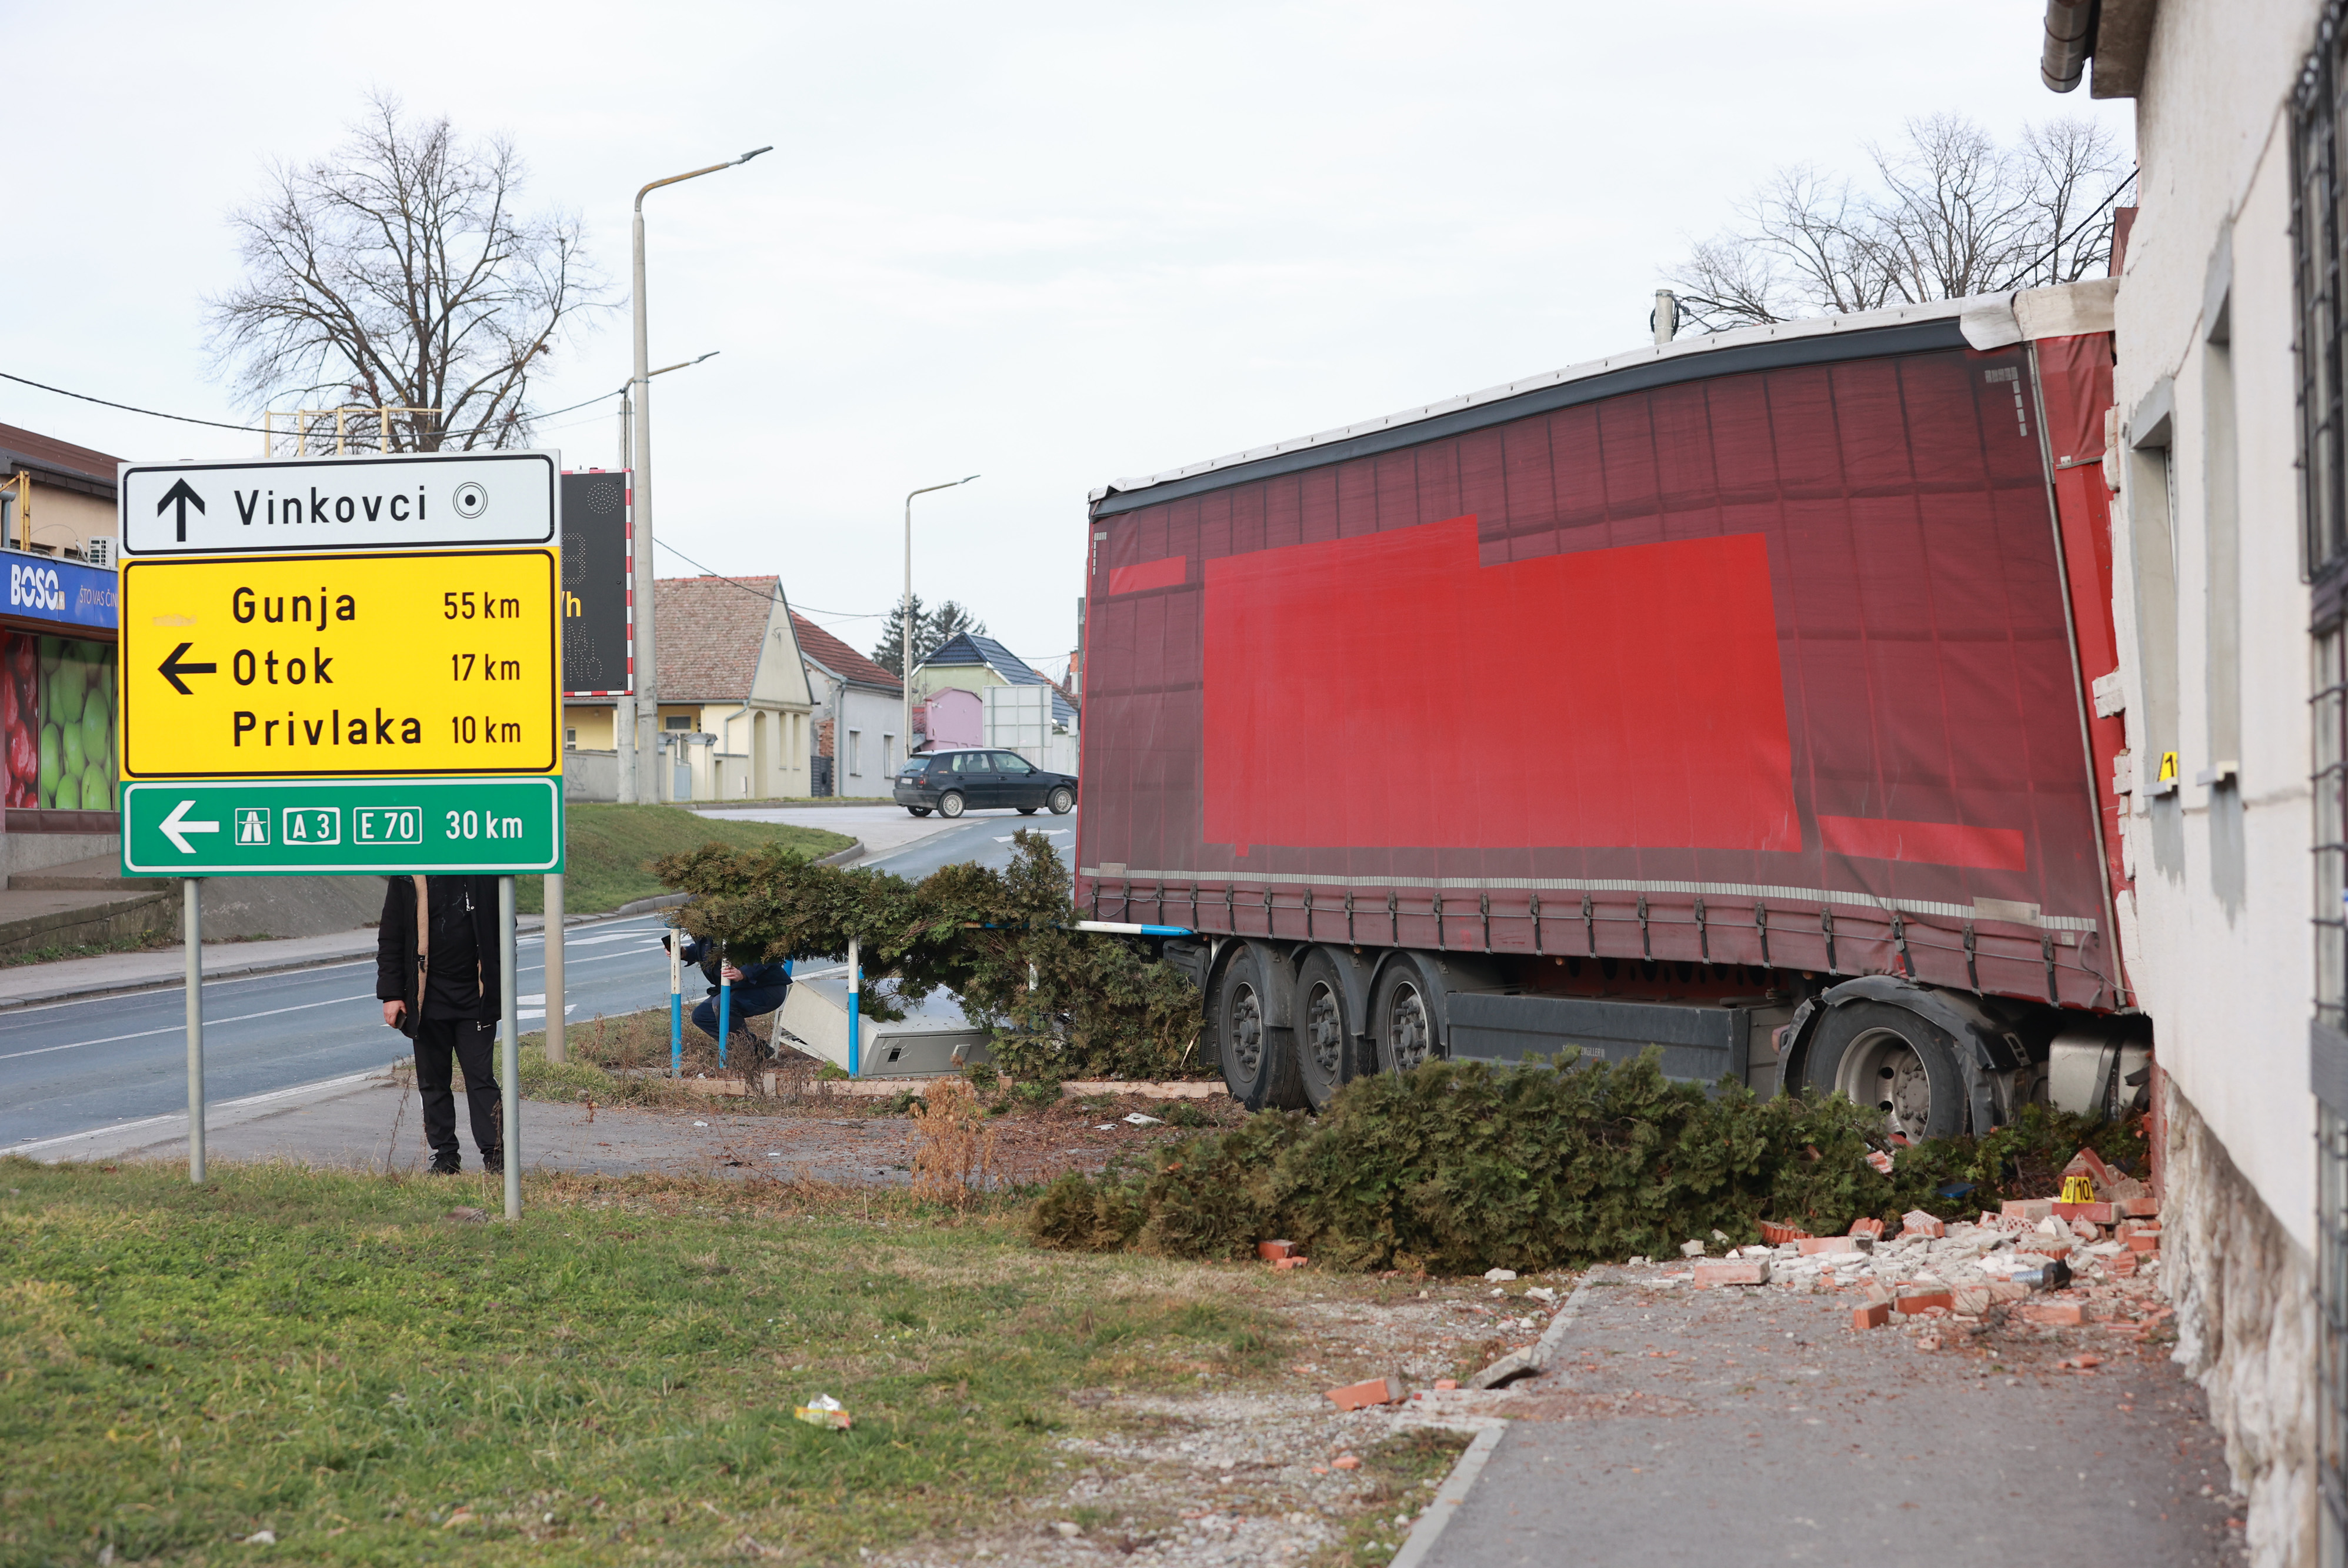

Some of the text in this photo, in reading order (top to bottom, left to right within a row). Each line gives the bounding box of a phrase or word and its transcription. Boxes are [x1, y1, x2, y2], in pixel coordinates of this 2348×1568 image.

[234, 485, 425, 526] Vinkovci
[11, 564, 59, 610] BOSO
[79, 584, 92, 604] ŠTO
[92, 590, 105, 606] VAS
[233, 586, 519, 632] Gunja 55 km
[233, 646, 520, 686] Otok 17 km
[234, 707, 521, 747] Privlaka 10 km
[292, 813, 330, 839] A 3
[362, 812, 414, 839] E 70
[446, 810, 522, 839] 30 km
[2077, 1179, 2090, 1200] 10
